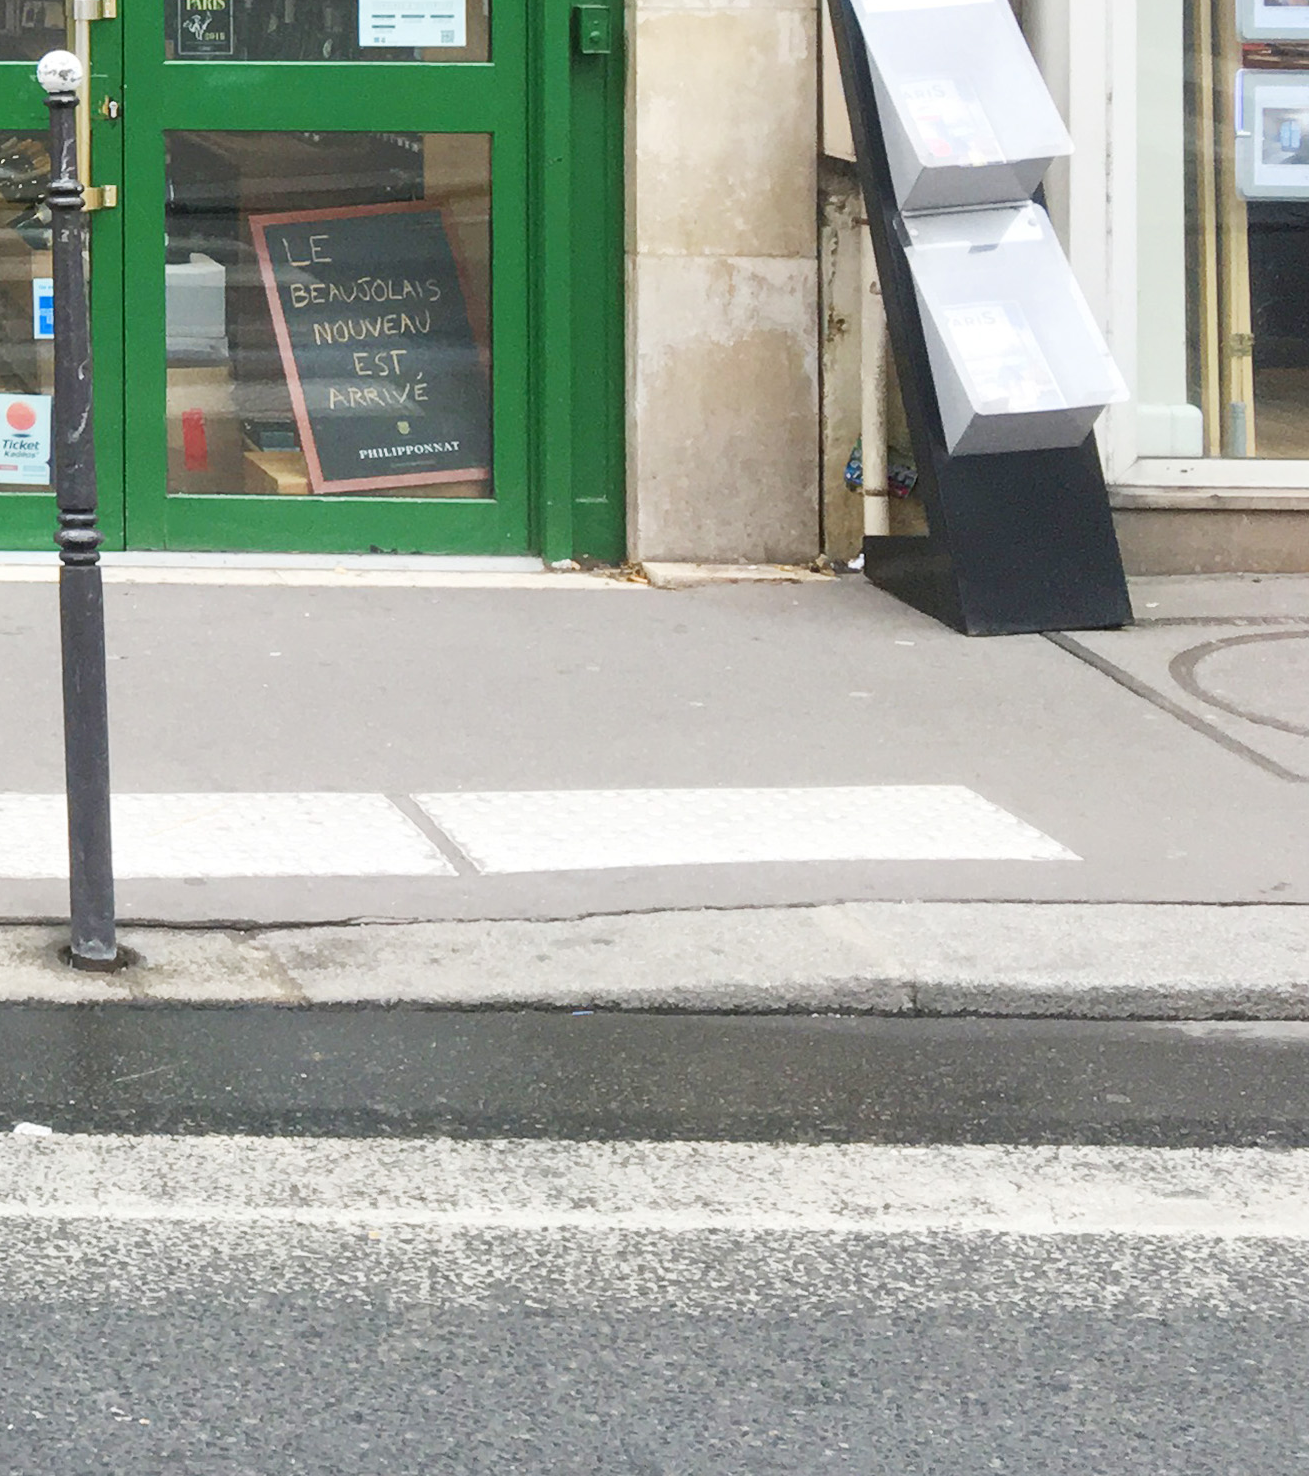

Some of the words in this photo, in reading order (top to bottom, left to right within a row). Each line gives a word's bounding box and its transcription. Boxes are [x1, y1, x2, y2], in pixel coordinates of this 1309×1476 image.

[282, 235, 332, 266] LE
[290, 276, 442, 308] BEAUJOLAIS
[313, 310, 431, 345] NOUVEAU
[353, 350, 408, 376] EST
[2, 439, 41, 451] Ticket
[358, 440, 461, 460] PHILIPPONNAT
